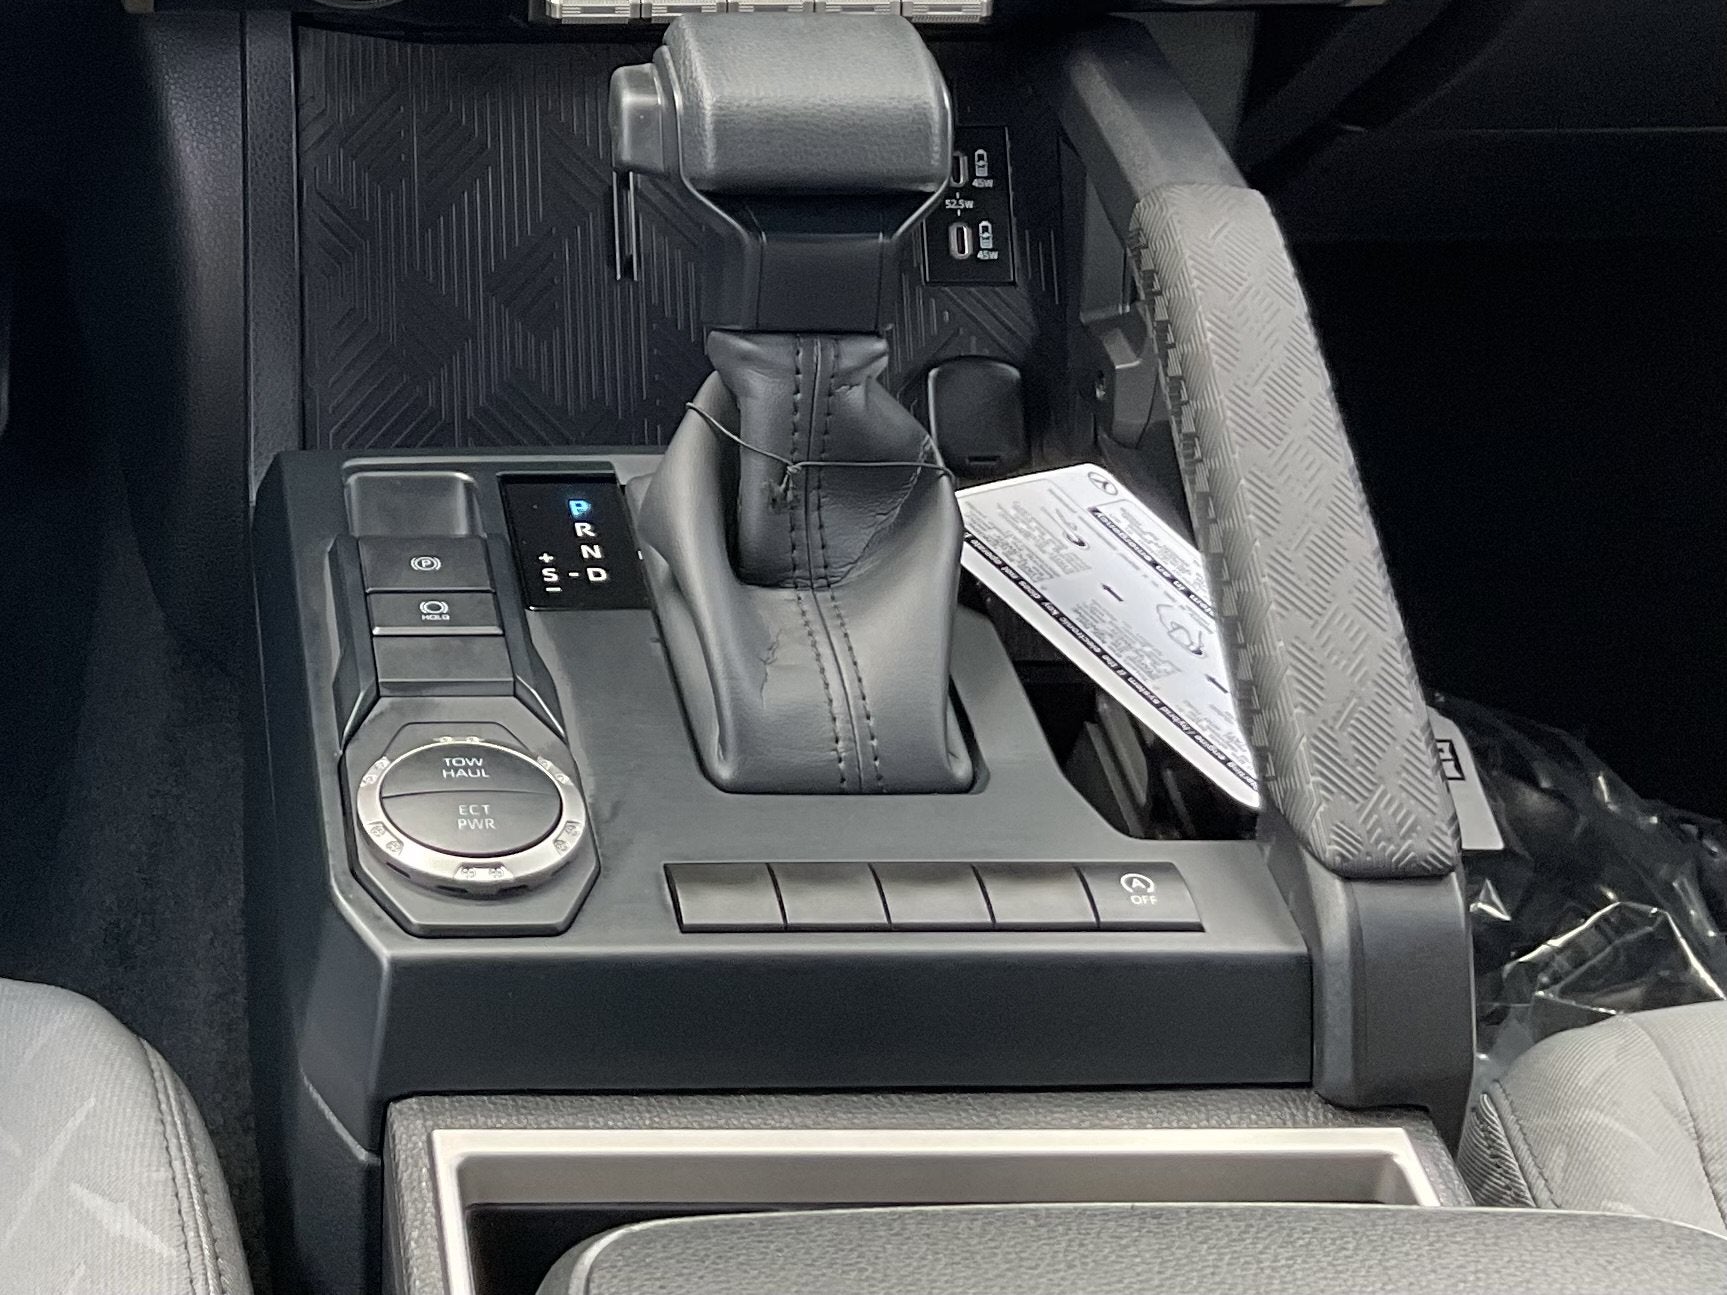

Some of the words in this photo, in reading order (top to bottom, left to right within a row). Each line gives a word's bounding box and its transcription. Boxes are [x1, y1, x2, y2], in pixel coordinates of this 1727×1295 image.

[972, 178, 994, 188] 45W
[977, 250, 999, 260] 45W
[569, 499, 592, 516] P
[574, 522, 596, 537] R
[1097, 511, 1153, 563] emergency
[580, 544, 603, 559] N
[541, 567, 559, 582] S
[587, 567, 608, 582] D
[443, 757, 484, 767] TOW
[442, 768, 491, 779] HAUL
[458, 804, 492, 815] ECT
[457, 818, 496, 829] PWR
[1130, 895, 1158, 905] OFF
